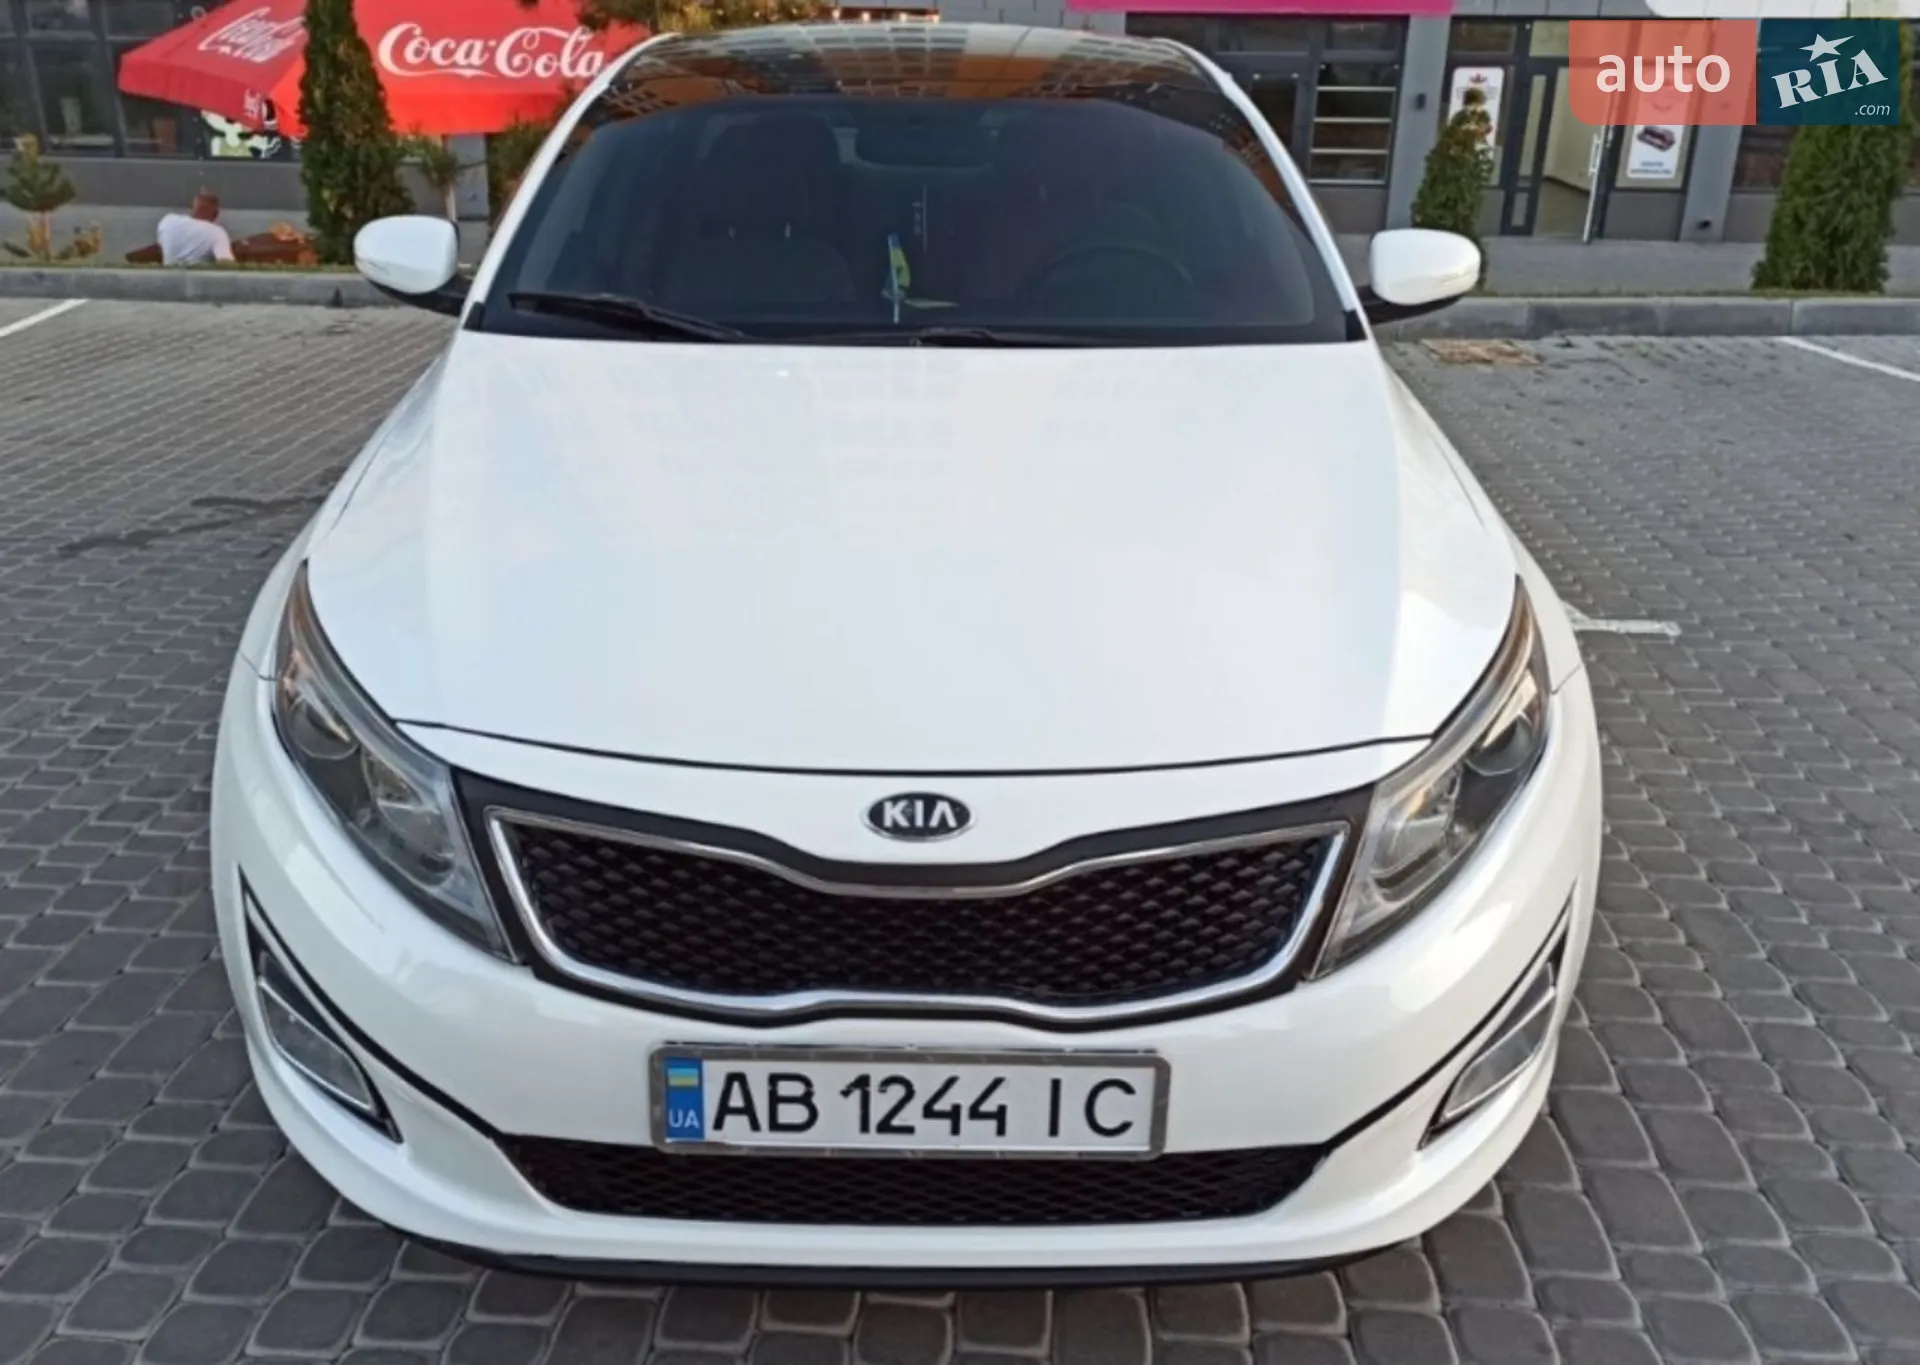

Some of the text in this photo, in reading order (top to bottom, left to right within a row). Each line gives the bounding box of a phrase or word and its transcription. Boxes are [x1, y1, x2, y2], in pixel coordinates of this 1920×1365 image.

[378, 21, 605, 78] Coca-Cola
[883, 800, 957, 828] KIA
[669, 1109, 700, 1128] UA
[712, 1071, 819, 1133] AB
[839, 1073, 1008, 1137] 1244
